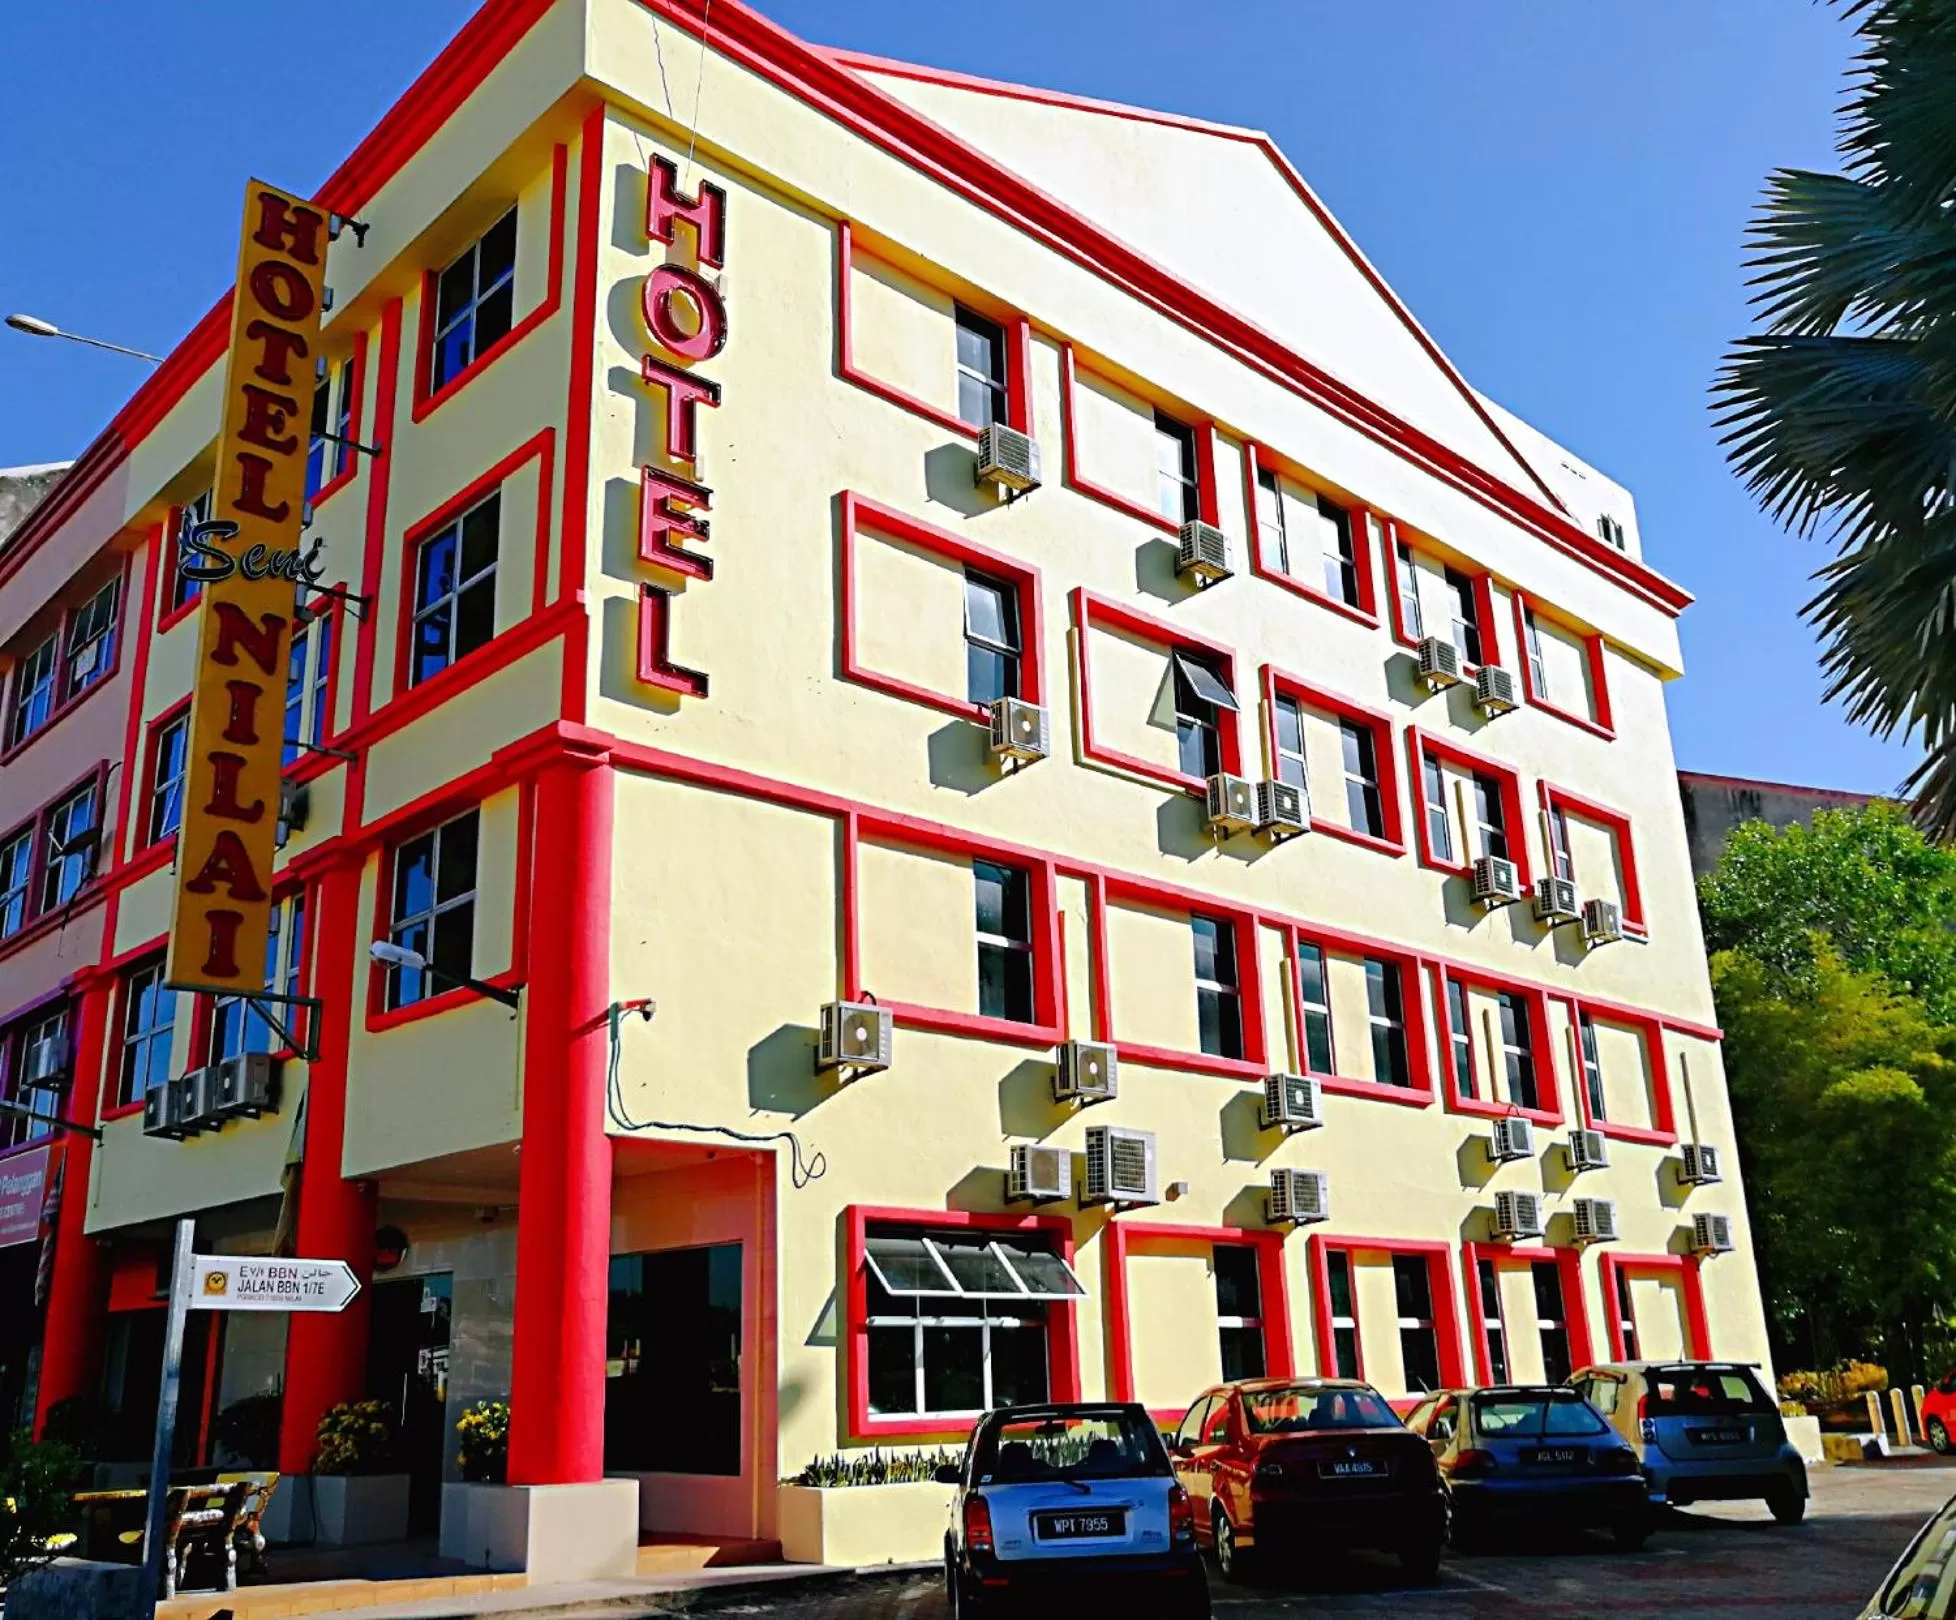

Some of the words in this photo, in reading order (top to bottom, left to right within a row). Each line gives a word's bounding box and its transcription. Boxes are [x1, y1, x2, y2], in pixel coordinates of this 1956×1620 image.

[232, 191, 323, 524] HOTEL
[636, 152, 728, 699] HOTEL
[179, 520, 327, 583] Seni
[186, 601, 287, 979] NILAI
[237, 1279, 274, 1294] JALAN
[277, 1281, 300, 1294] BBN
[303, 1283, 325, 1295] 1/7E
[268, 1266, 298, 1280] BBN
[1053, 1518, 1075, 1533] WPT
